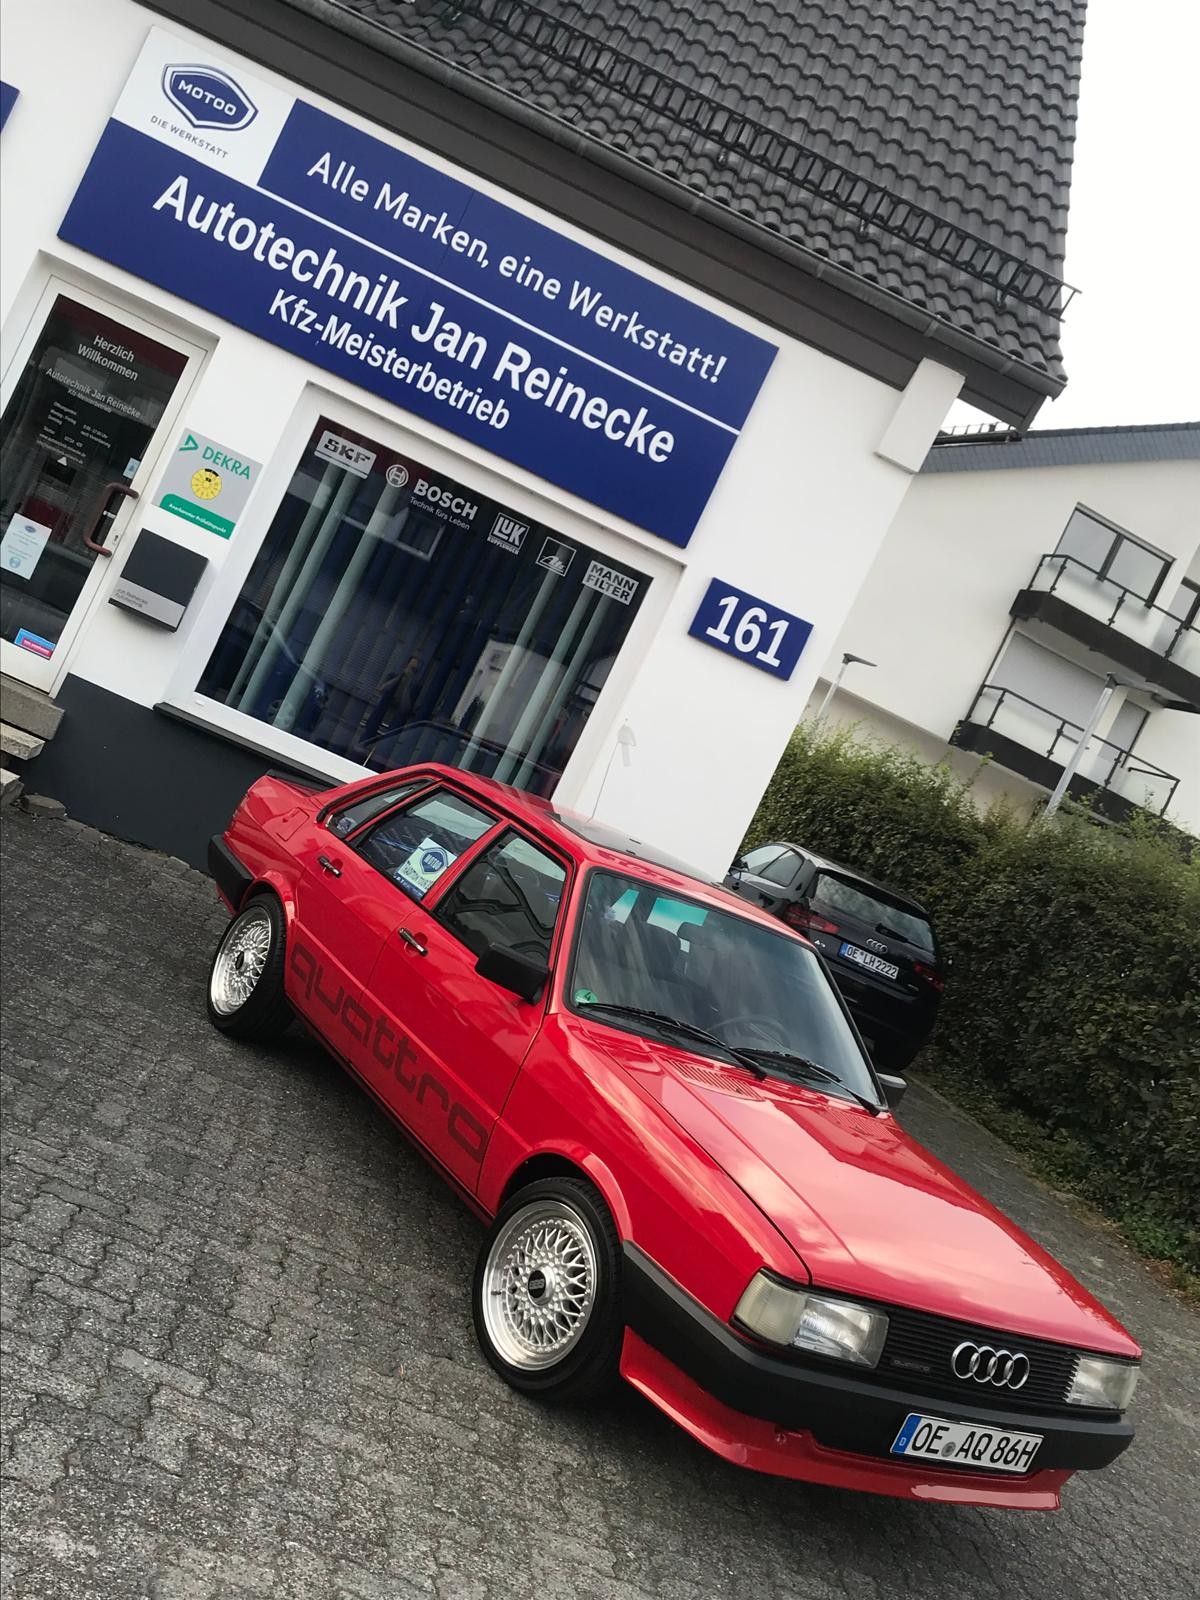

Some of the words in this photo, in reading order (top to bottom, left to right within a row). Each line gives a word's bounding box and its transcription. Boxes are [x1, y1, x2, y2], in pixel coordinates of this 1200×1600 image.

[177, 79, 237, 117] MOTOO
[150, 114, 169, 131] DIE
[169, 125, 230, 160] WERKSTATT
[306, 151, 370, 203] Alle
[373, 182, 491, 269] Marken,
[498, 254, 562, 300] eine
[566, 280, 728, 383] Werkstatt!
[152, 174, 409, 330] Autotechnik
[410, 301, 488, 370] Jan
[492, 341, 675, 463] Reinecke
[77, 343, 139, 381] Willkommen
[93, 335, 135, 363] Herzlich
[268, 288, 511, 430] Kfz-Meisterbetrieb
[45, 367, 91, 395] Autotechnik
[91, 388, 106, 402] Jan
[106, 396, 142, 419] Reinecke
[201, 446, 251, 480] DEKRA
[324, 438, 371, 464] SKF
[410, 497, 435, 514] Technik
[435, 508, 448, 521] fürs
[448, 514, 471, 531] Leben
[413, 478, 479, 520] BOSCH
[586, 574, 631, 601] FILTER
[590, 564, 636, 592] MANN
[706, 595, 789, 668] 161
[847, 947, 859, 959] OE
[863, 953, 877, 967] LH
[876, 960, 897, 977] 2222
[290, 942, 489, 1164] quattro
[911, 1422, 950, 1455] OE
[955, 1430, 993, 1461] AQ
[990, 1437, 1039, 1468] 86H
